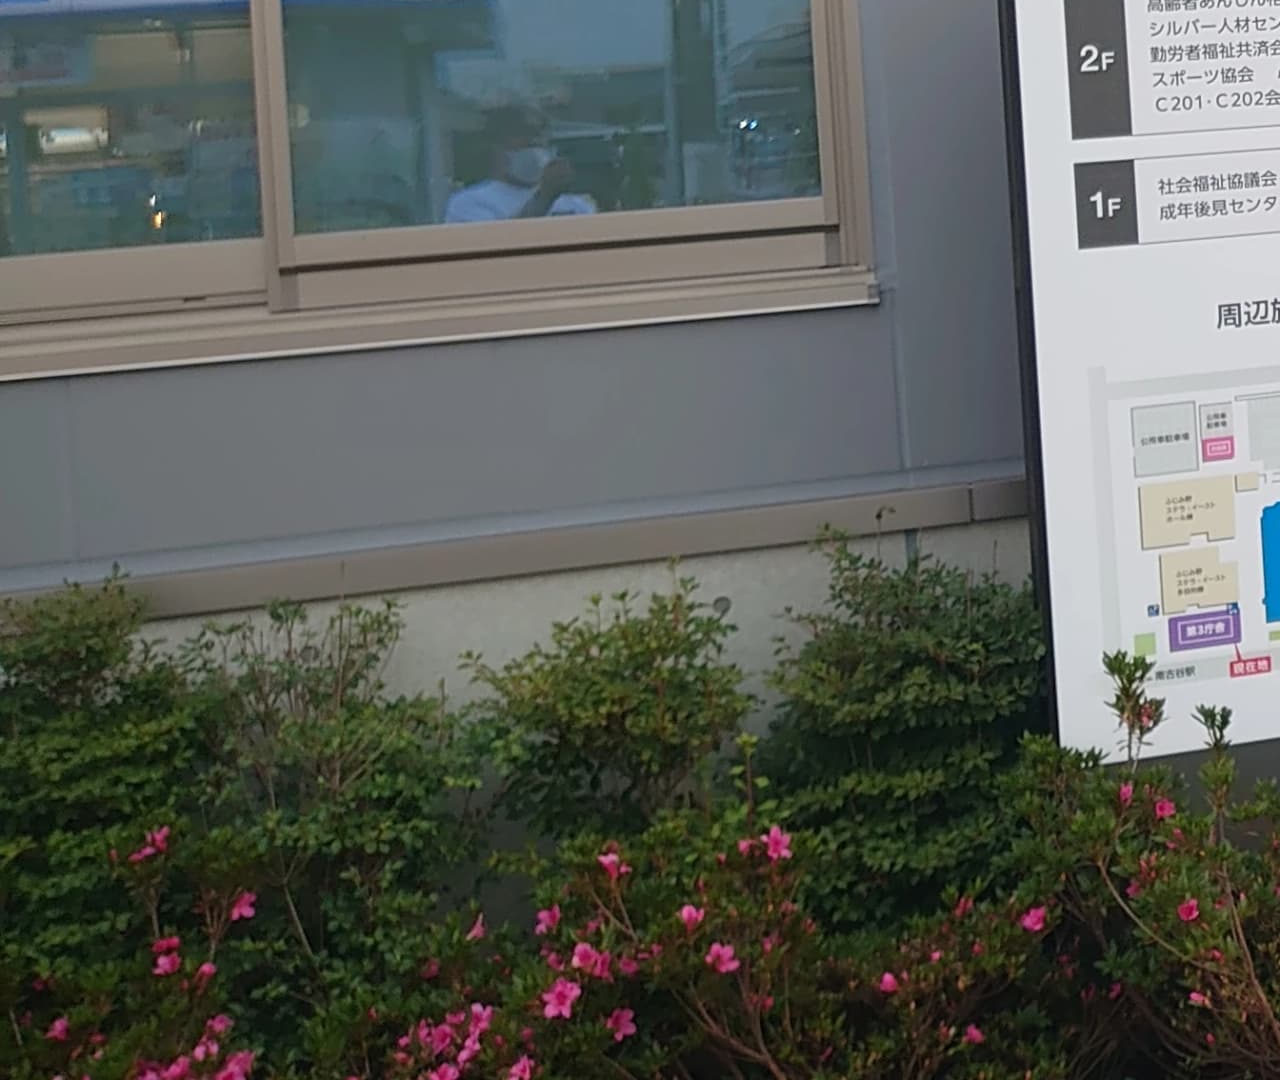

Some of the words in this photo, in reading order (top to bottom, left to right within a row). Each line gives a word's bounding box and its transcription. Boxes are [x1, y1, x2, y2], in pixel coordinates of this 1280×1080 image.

[1079, 45, 1116, 73] 2F
[1152, 65, 1255, 88] スポーツ協会
[1157, 169, 1278, 196] 社会福祉協議会
[1089, 191, 1122, 219] 1F
